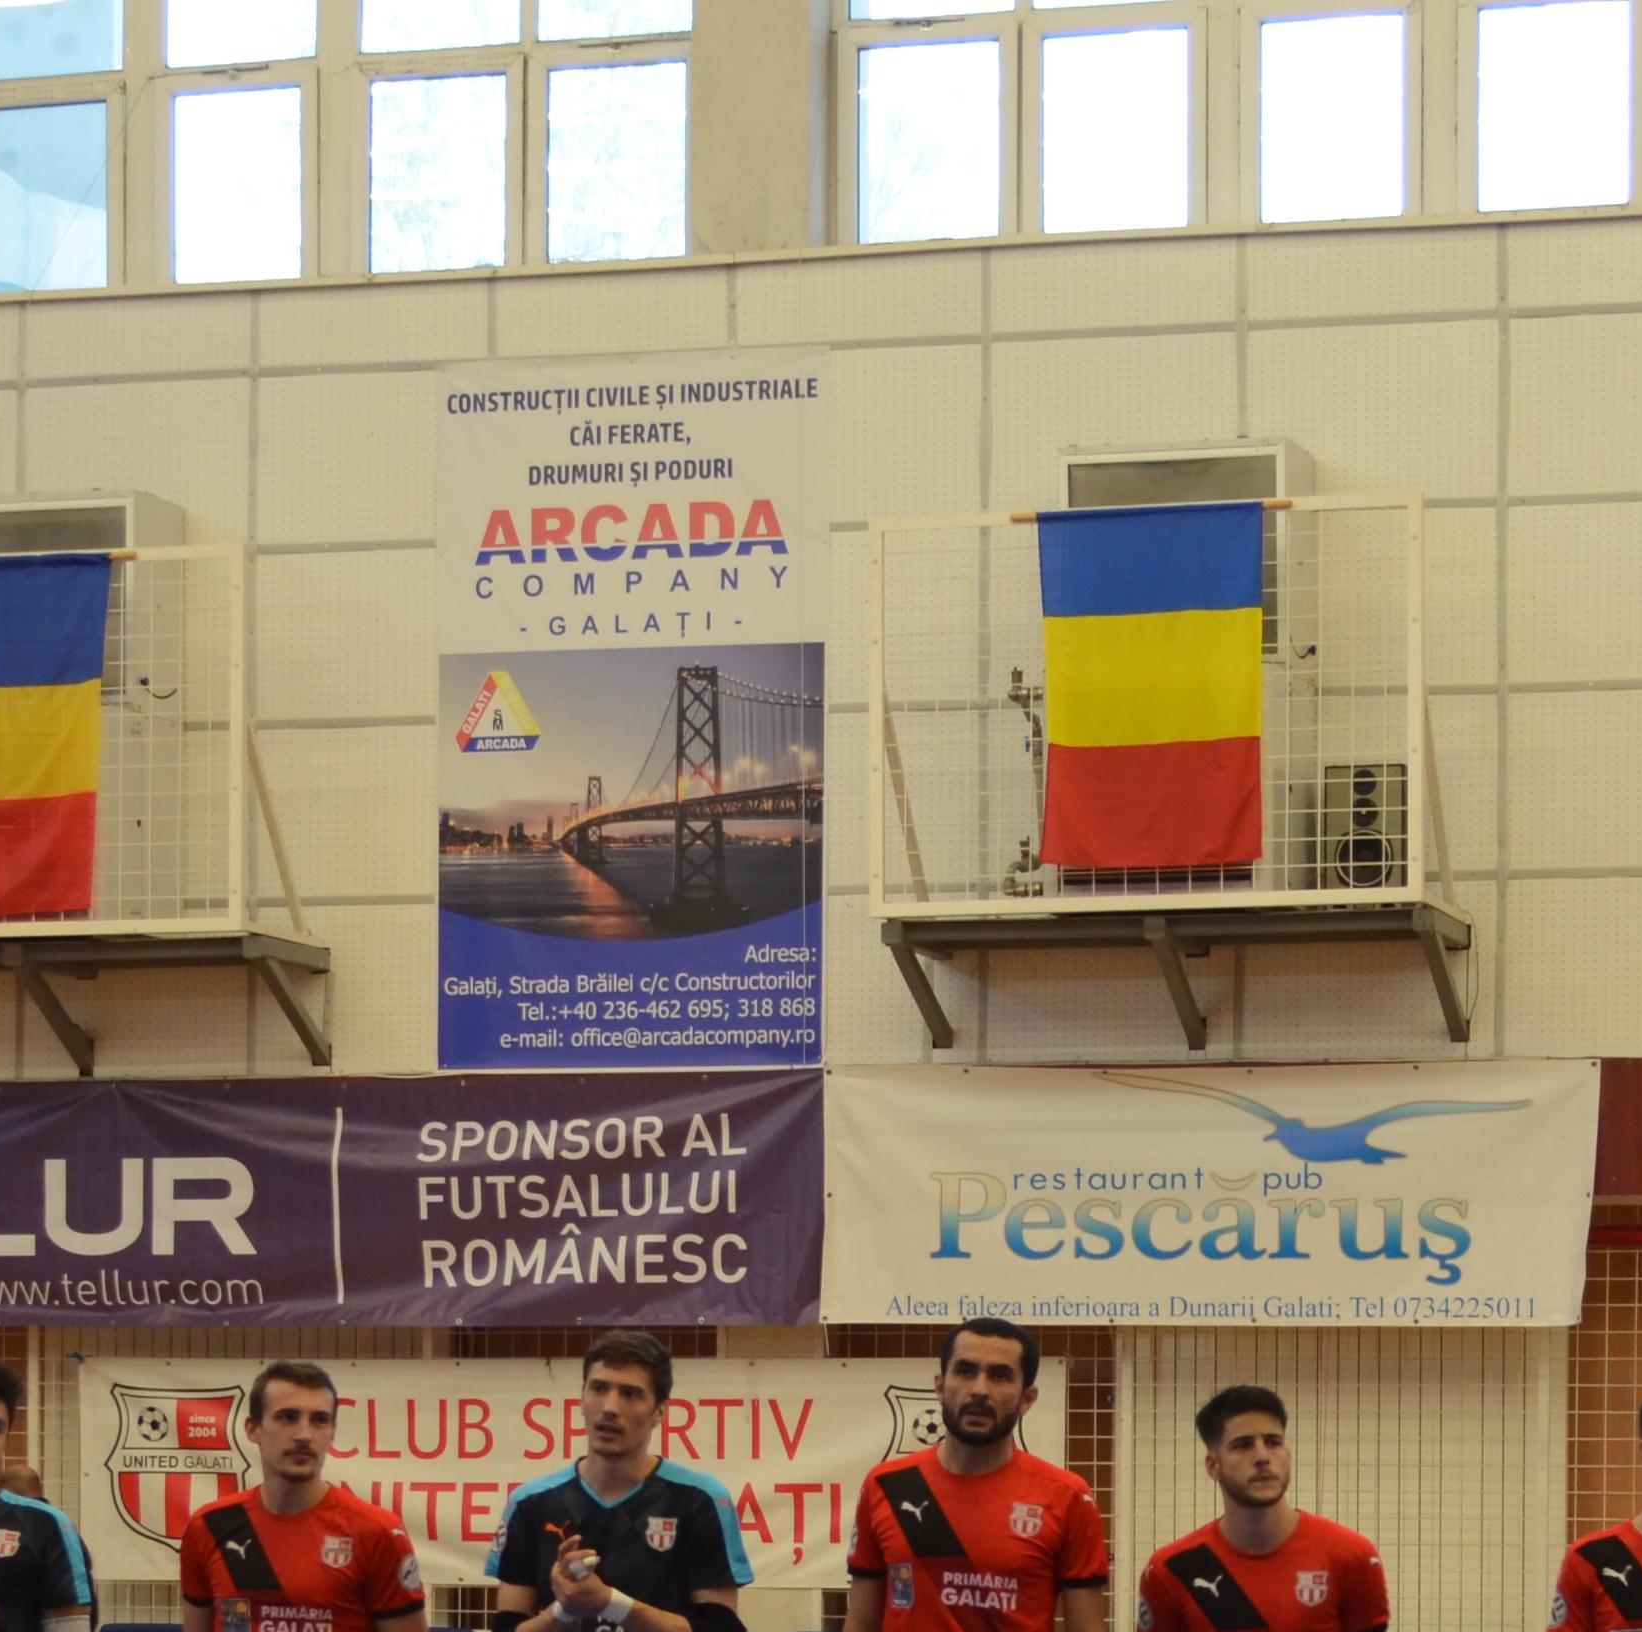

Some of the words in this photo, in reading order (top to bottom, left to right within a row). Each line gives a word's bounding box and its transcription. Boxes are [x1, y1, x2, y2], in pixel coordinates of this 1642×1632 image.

[447, 388, 580, 414] CONSTRUCȚII
[586, 385, 650, 409] CIVILE
[656, 384, 674, 409] ȘI
[680, 378, 818, 404] INDUSTRIALE
[570, 421, 602, 447] CĂI
[608, 422, 691, 445] FERATE,
[528, 463, 624, 486] DRUMURI
[630, 462, 648, 488] ȘI
[655, 458, 733, 481] PODURI
[474, 499, 789, 566] ARCADA
[475, 565, 789, 599] COMPANY
[548, 611, 713, 637] GALAȚI
[477, 738, 527, 751] ARCADA
[744, 944, 817, 963] Adresa:
[443, 977, 503, 999] Galați,
[509, 975, 570, 996] Strada
[576, 972, 634, 994] Brăilei
[640, 972, 670, 996] c/c
[675, 970, 816, 993] Constructorilor
[603, 999, 682, 1020] 236-462
[687, 999, 731, 1022] 695;
[737, 997, 774, 1018] 318
[780, 996, 817, 1017] 868
[499, 1029, 565, 1049] e-mail:
[570, 1026, 817, 1050] office@arcadacompany.ro
[415, 1115, 666, 1163] SPONSOR
[681, 1112, 748, 1158] AL
[1012, 1165, 1207, 1192] restaurant
[1261, 1162, 1325, 1196] pub
[417, 1170, 738, 1222] FUTSALULUI
[421, 1223, 748, 1289] ROMÂNESC
[885, 1295, 949, 1318] Aleea
[958, 1295, 1024, 1318] faleza
[1031, 1295, 1141, 1318] inferioara
[1148, 1301, 1161, 1318] a
[1168, 1295, 1256, 1318] Dunarii
[1263, 1295, 1343, 1321] Galati;
[1348, 1295, 1386, 1319] Tel
[1392, 1295, 1537, 1319] 0734225011
[188, 1413, 217, 1424] since
[328, 1398, 495, 1460] CLUB
[522, 1397, 815, 1460] SPRTIV
[187, 1427, 218, 1438] 2004
[123, 1455, 179, 1469] UNITED
